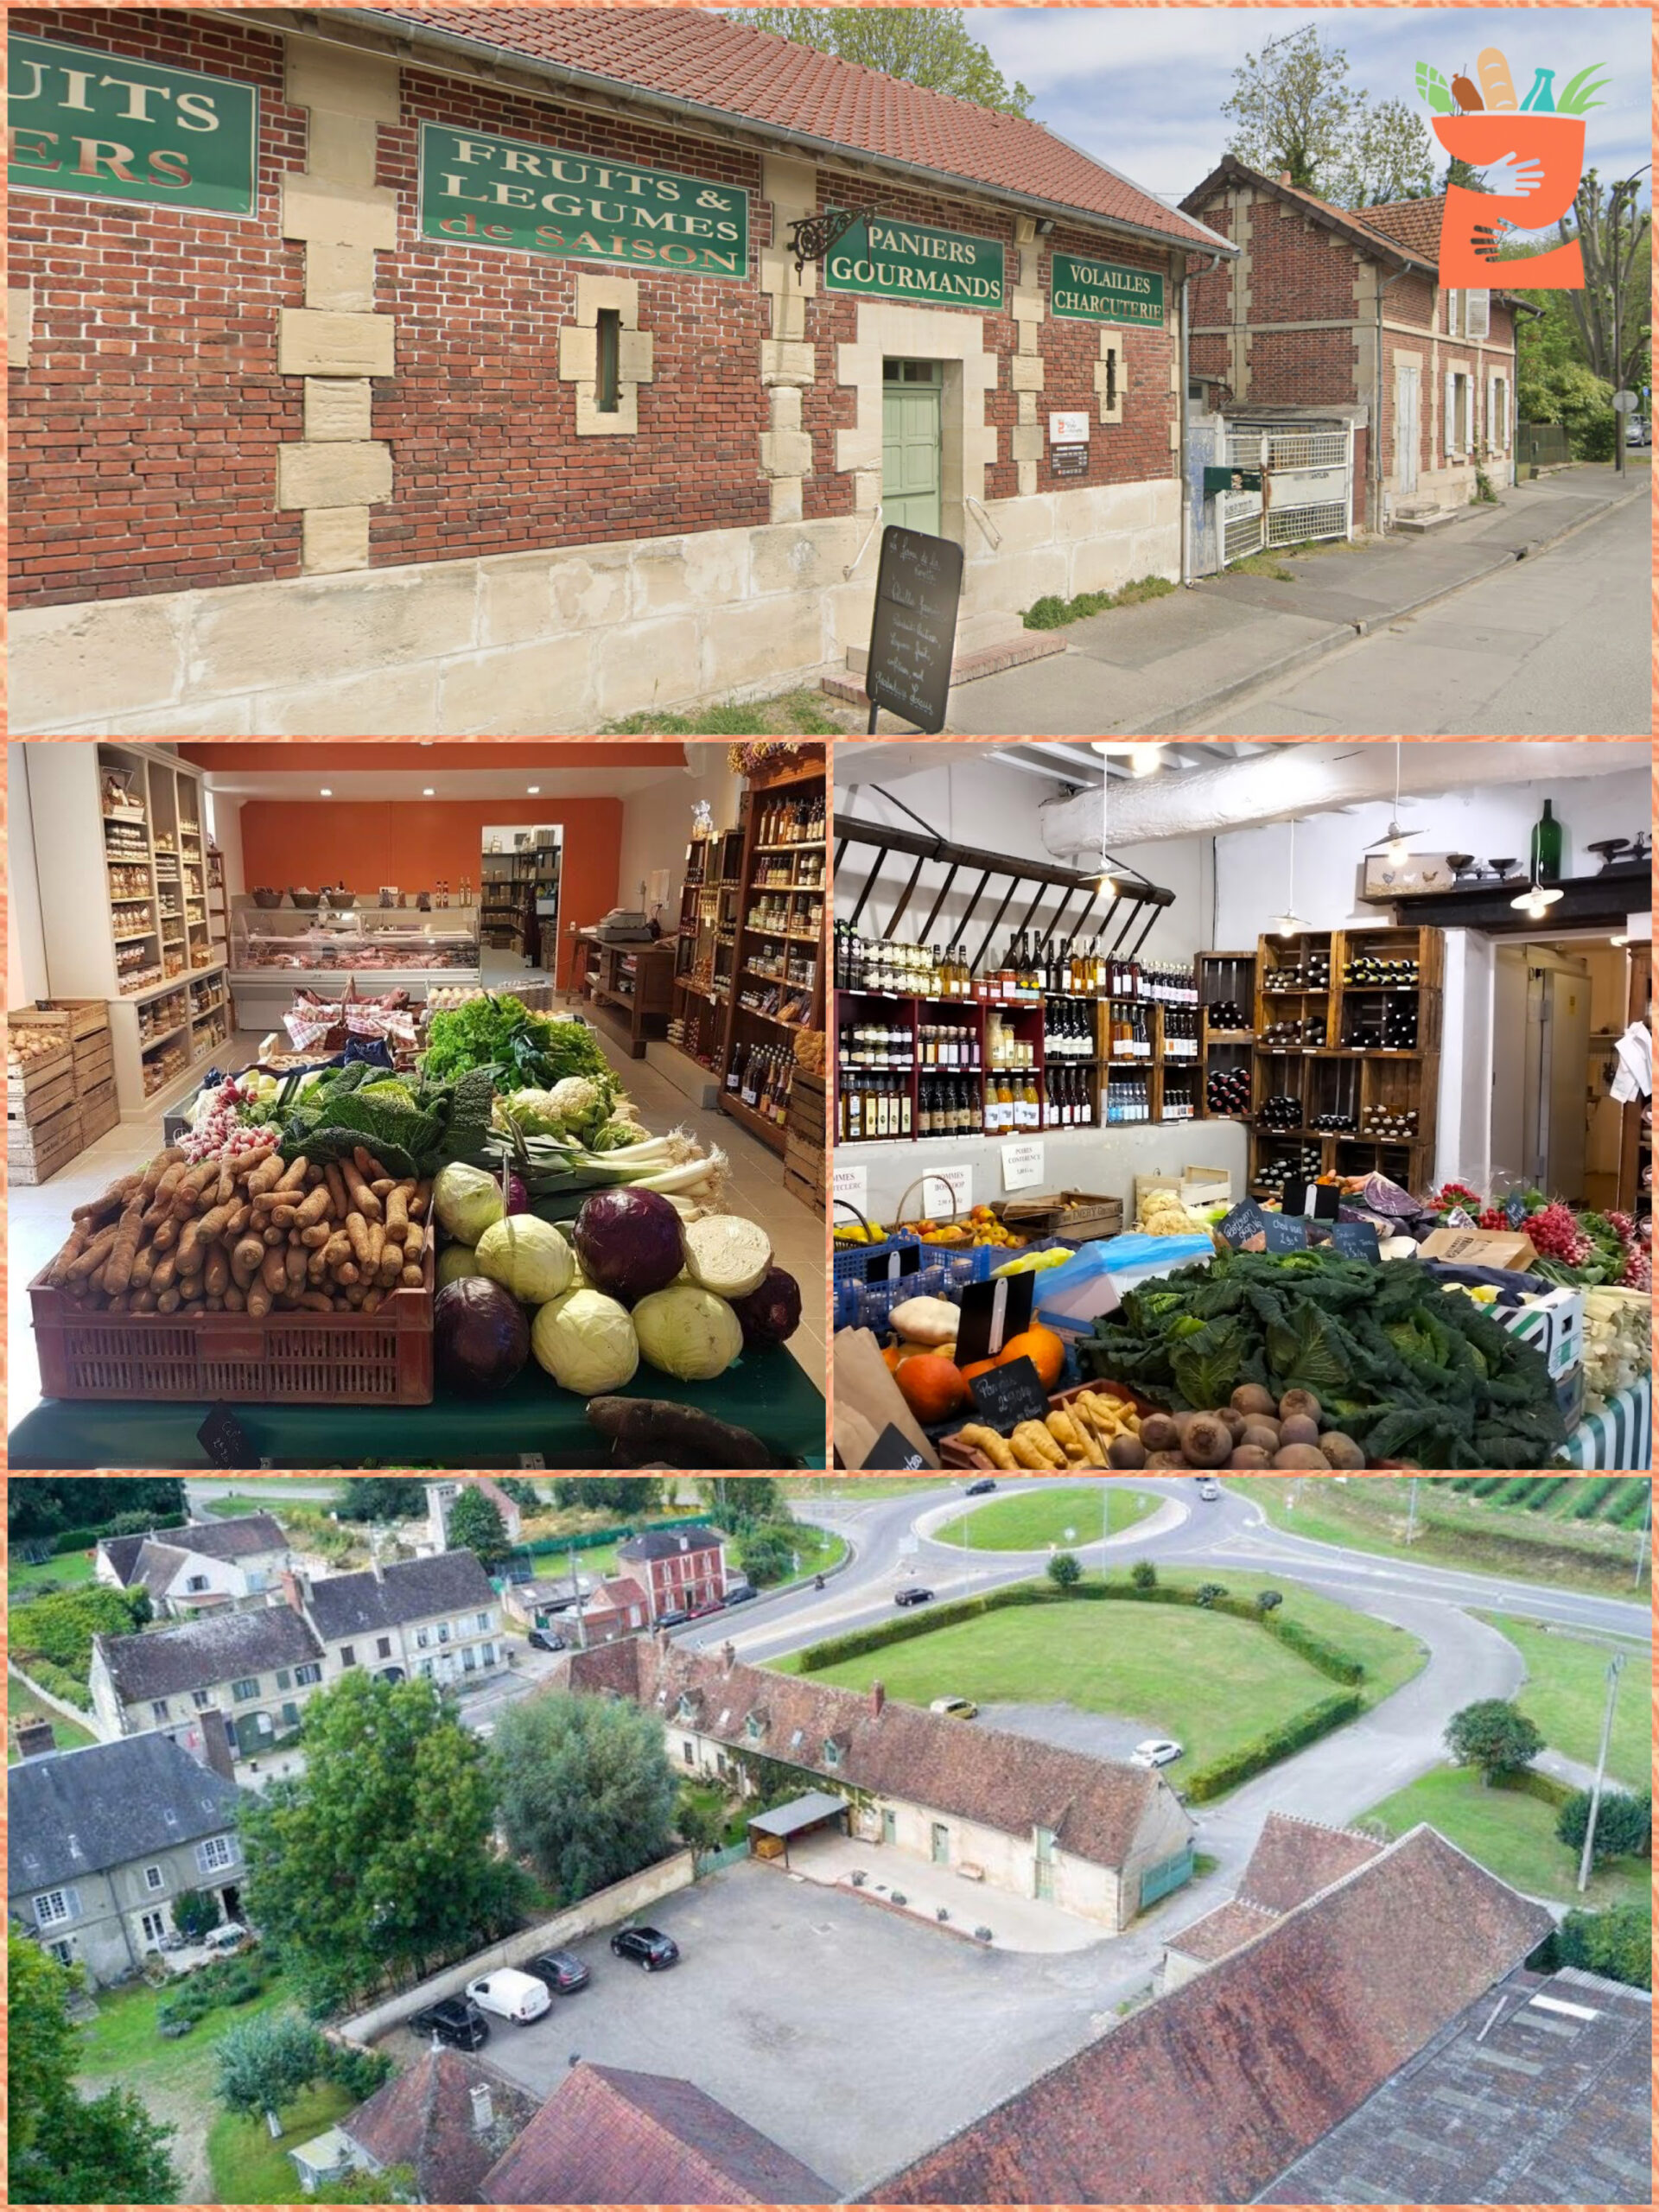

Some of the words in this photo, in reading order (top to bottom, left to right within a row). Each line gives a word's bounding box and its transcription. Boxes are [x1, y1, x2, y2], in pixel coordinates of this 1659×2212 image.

[451, 138, 680, 200] FRUITS
[696, 190, 732, 212] &
[438, 172, 739, 241] LEGUMES
[439, 213, 513, 240] de
[535, 224, 739, 271] SAISON
[868, 226, 977, 265] PANIERS
[831, 257, 1001, 301] GOURMANDS
[1069, 264, 1151, 295] VOLAILLES
[1054, 290, 1162, 321] CHARCUTERIE
[937, 1172, 964, 1180] OMMES
